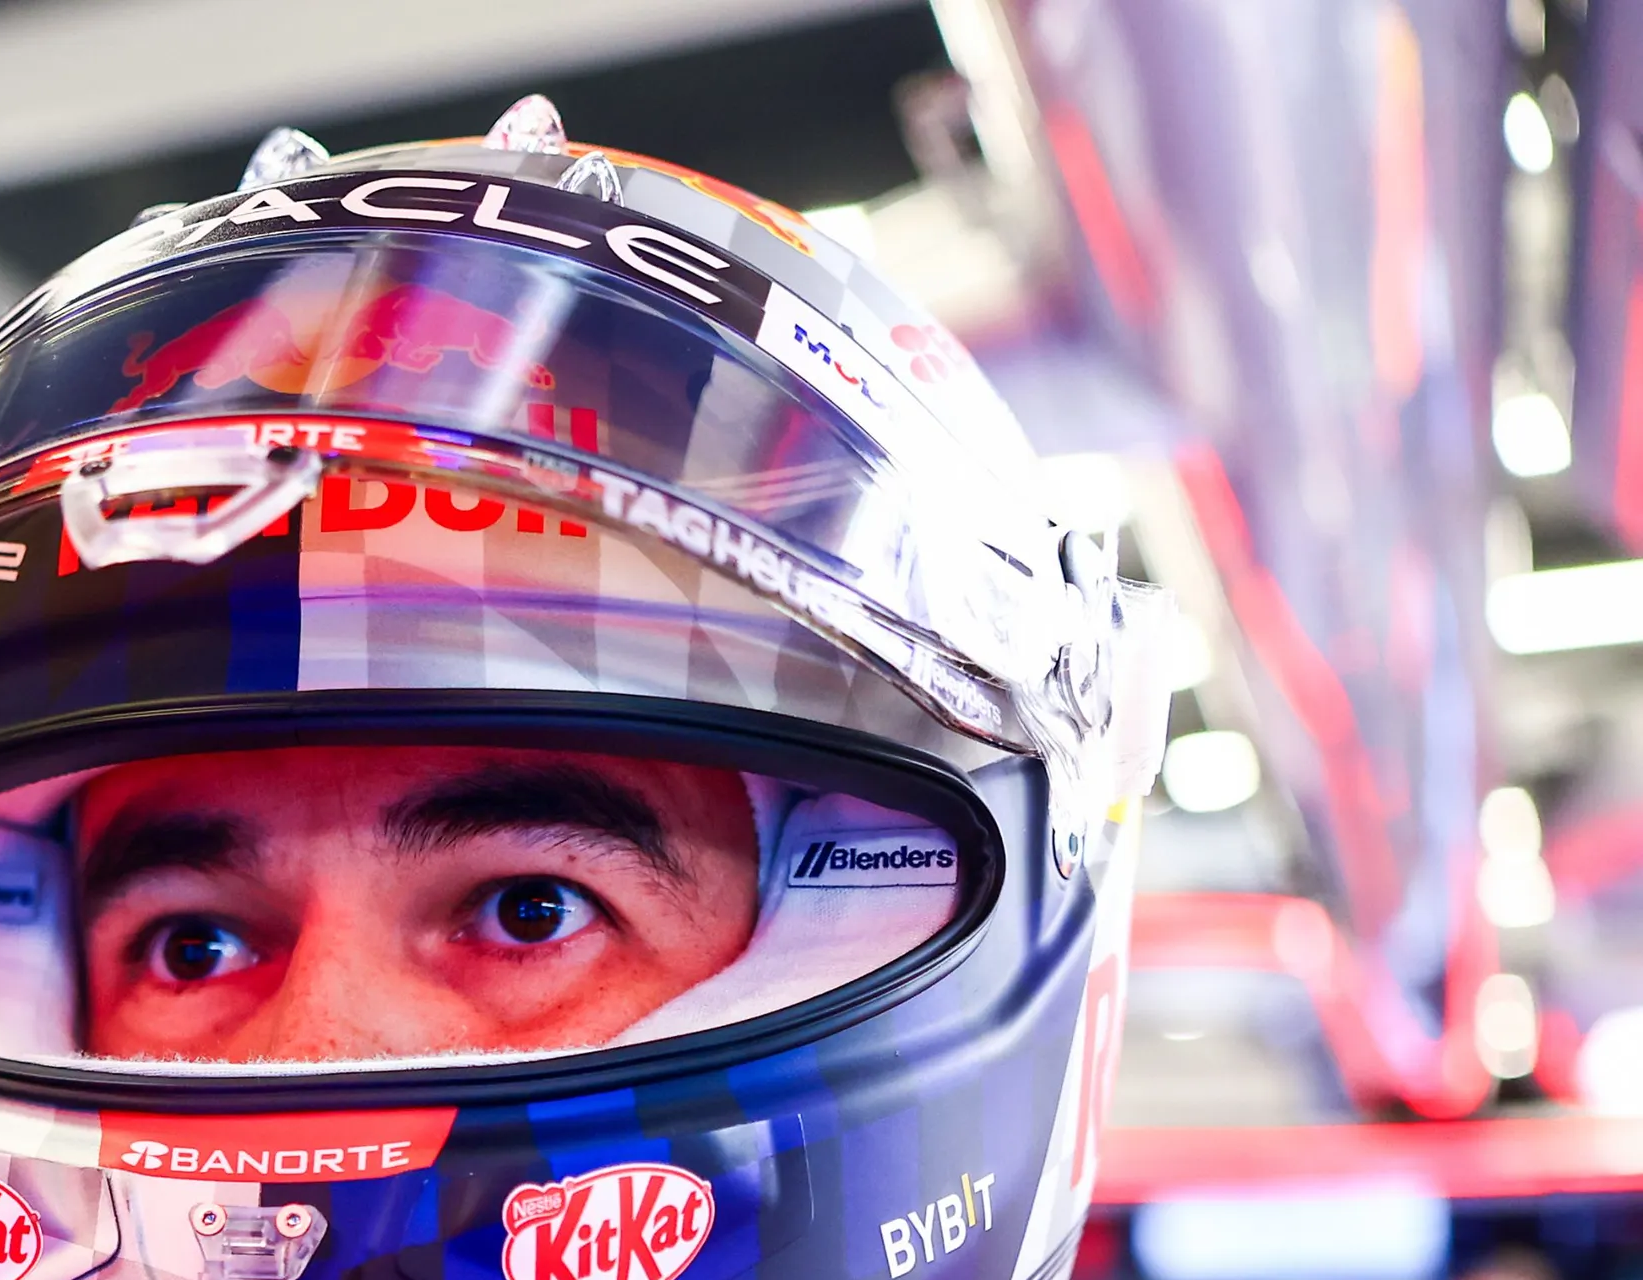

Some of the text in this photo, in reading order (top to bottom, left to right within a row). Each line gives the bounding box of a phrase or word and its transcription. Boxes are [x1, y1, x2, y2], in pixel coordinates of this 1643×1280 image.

[830, 843, 954, 873] Blenders
[170, 1140, 412, 1175] BANORTE
[879, 1172, 997, 1280] BYBIT
